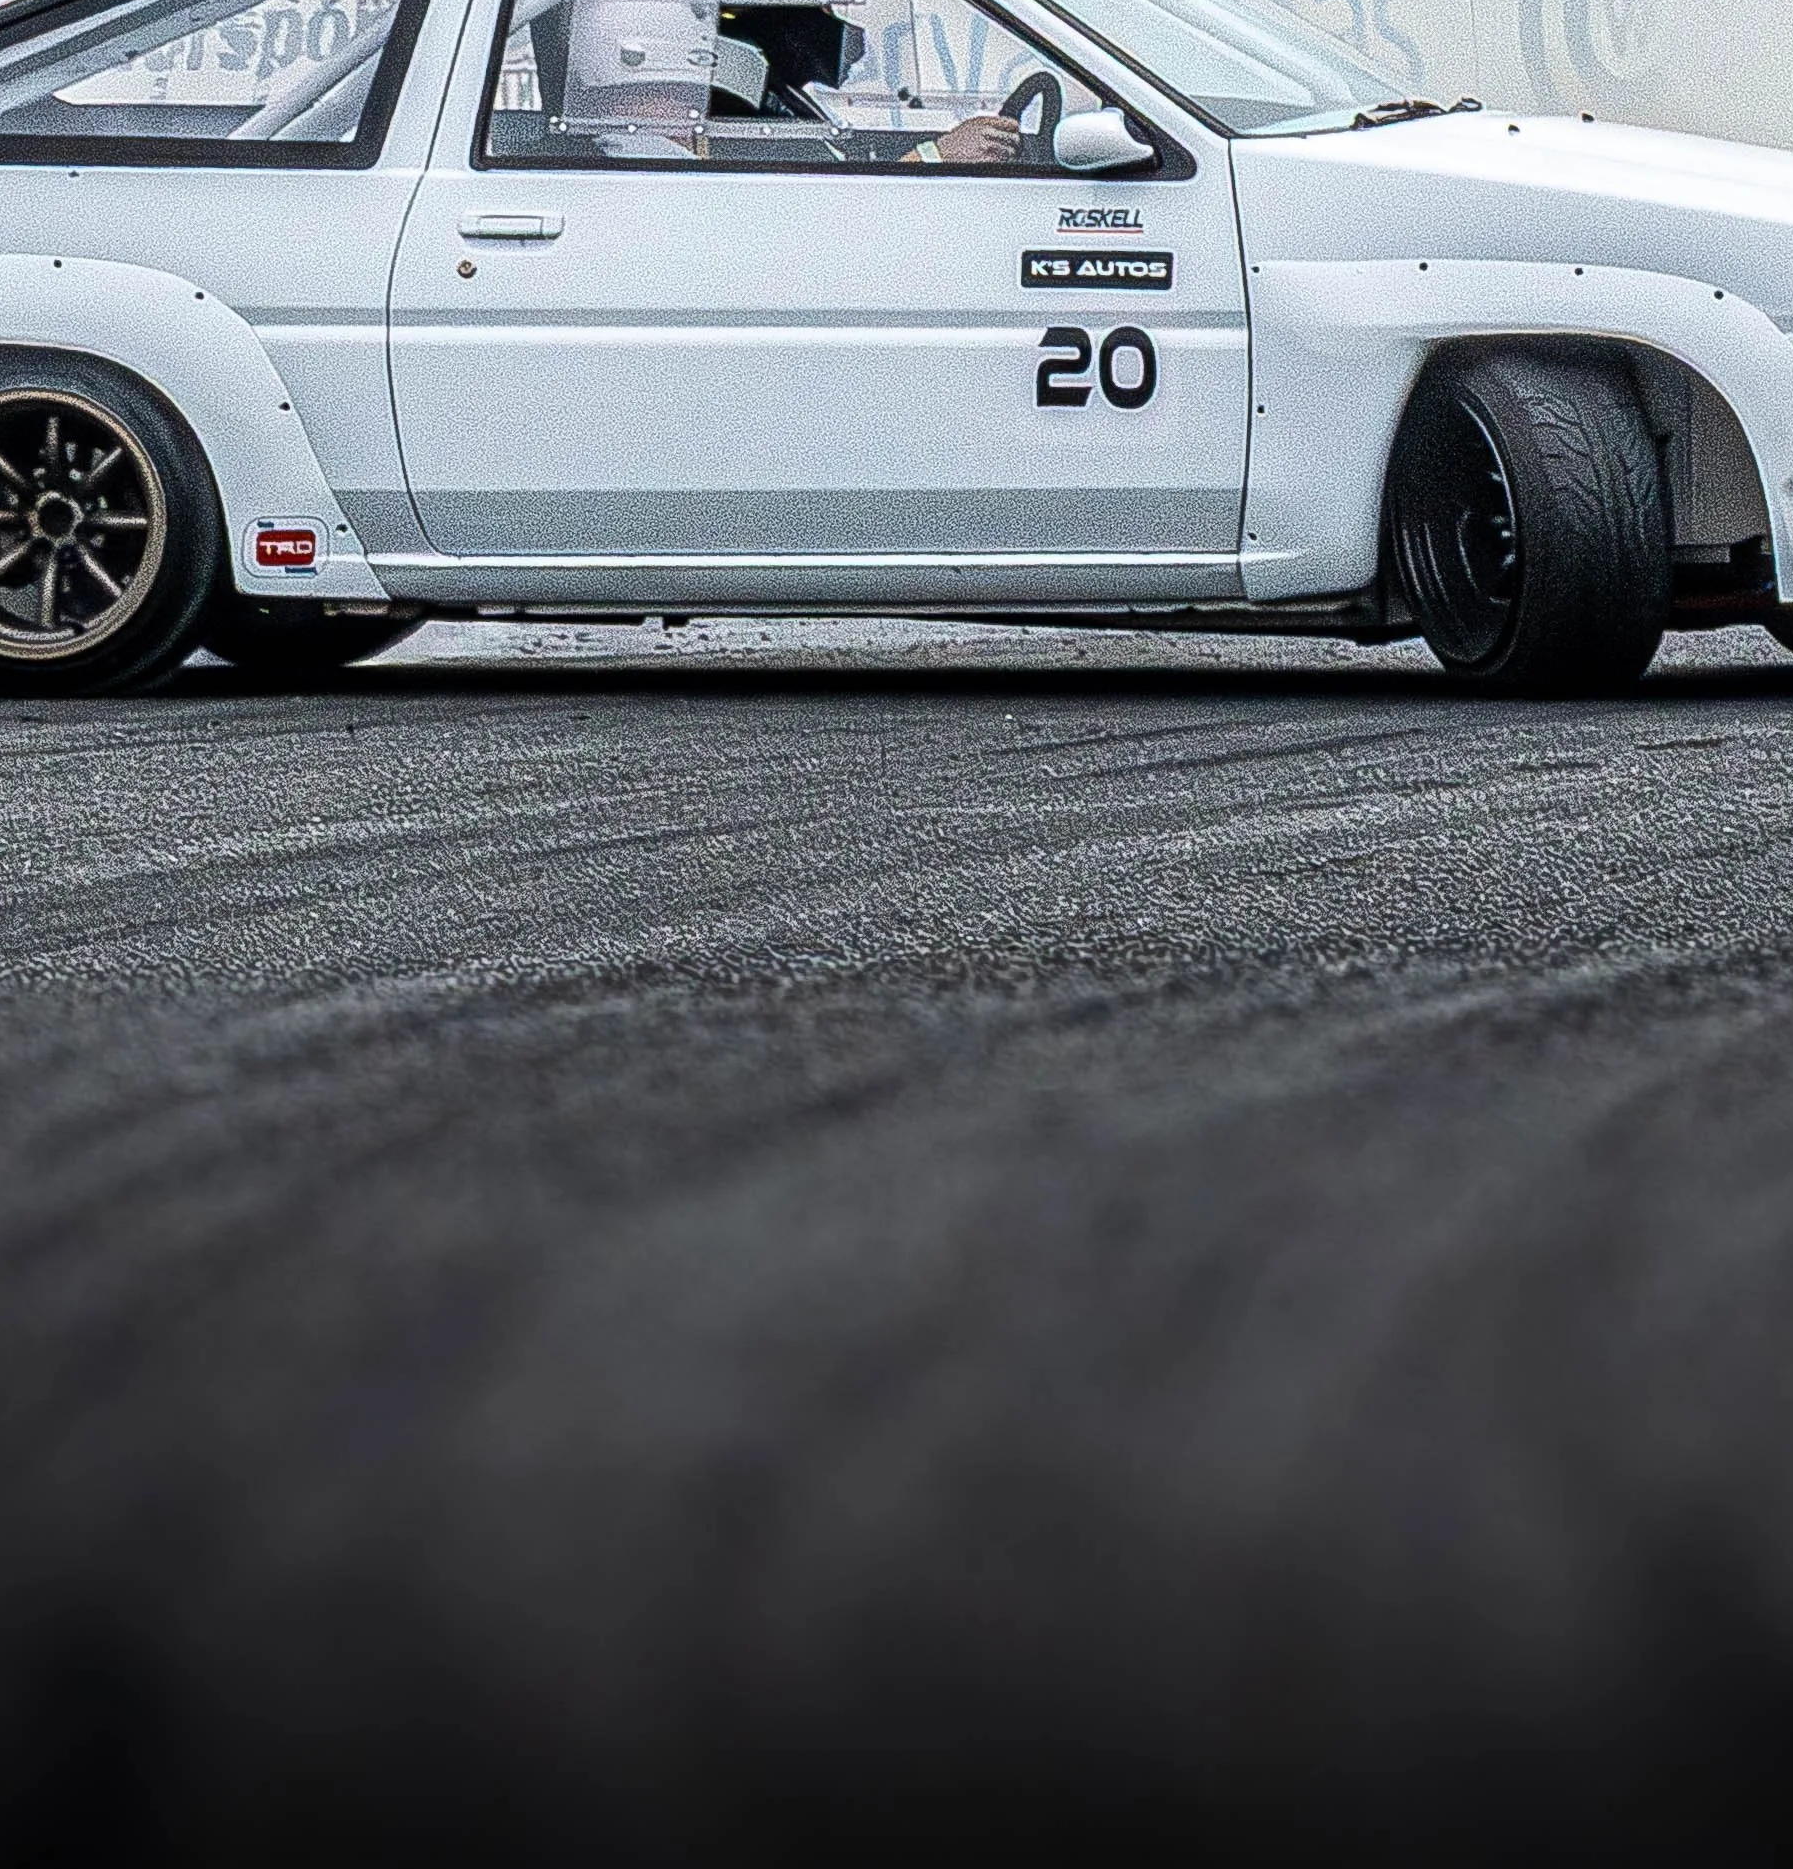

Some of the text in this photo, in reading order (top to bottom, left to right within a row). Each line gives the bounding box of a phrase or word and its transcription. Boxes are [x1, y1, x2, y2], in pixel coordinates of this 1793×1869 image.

[1058, 207, 1144, 229] ROSKELL
[1076, 259, 1168, 278] AUTOS
[1036, 326, 1156, 409] 20
[258, 539, 313, 556] TRD
